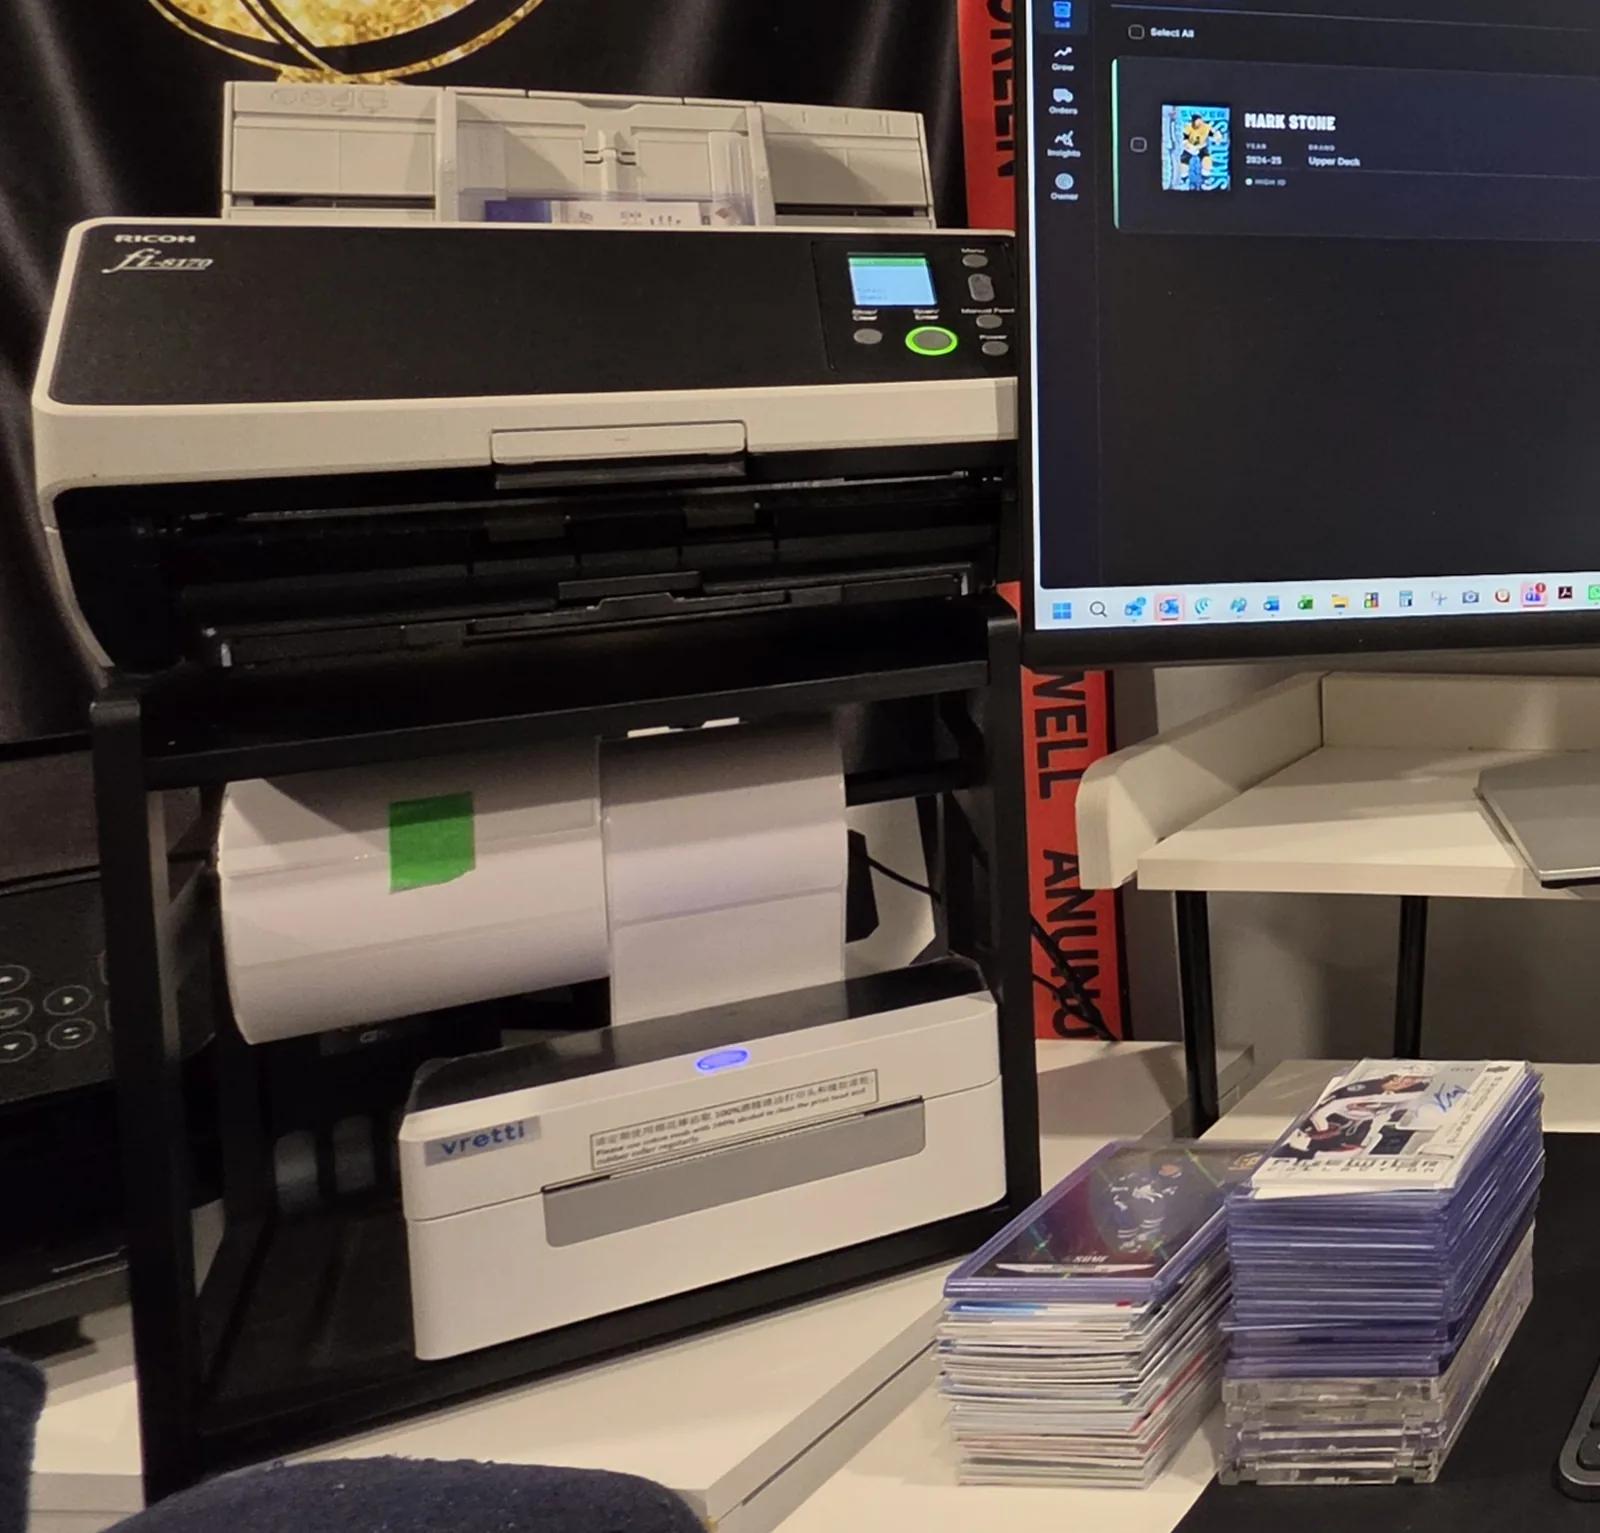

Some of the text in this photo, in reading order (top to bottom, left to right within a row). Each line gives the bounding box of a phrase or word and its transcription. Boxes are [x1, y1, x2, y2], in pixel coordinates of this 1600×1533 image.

[1150, 27, 1195, 38] Select All
[1051, 63, 1075, 72] Grow
[1048, 106, 1078, 115] Orders
[1244, 113, 1336, 131] MARK STONE
[1308, 156, 1361, 168] Upper Deck
[114, 234, 196, 244] RICOH
[441, 1120, 525, 1155] vretti
